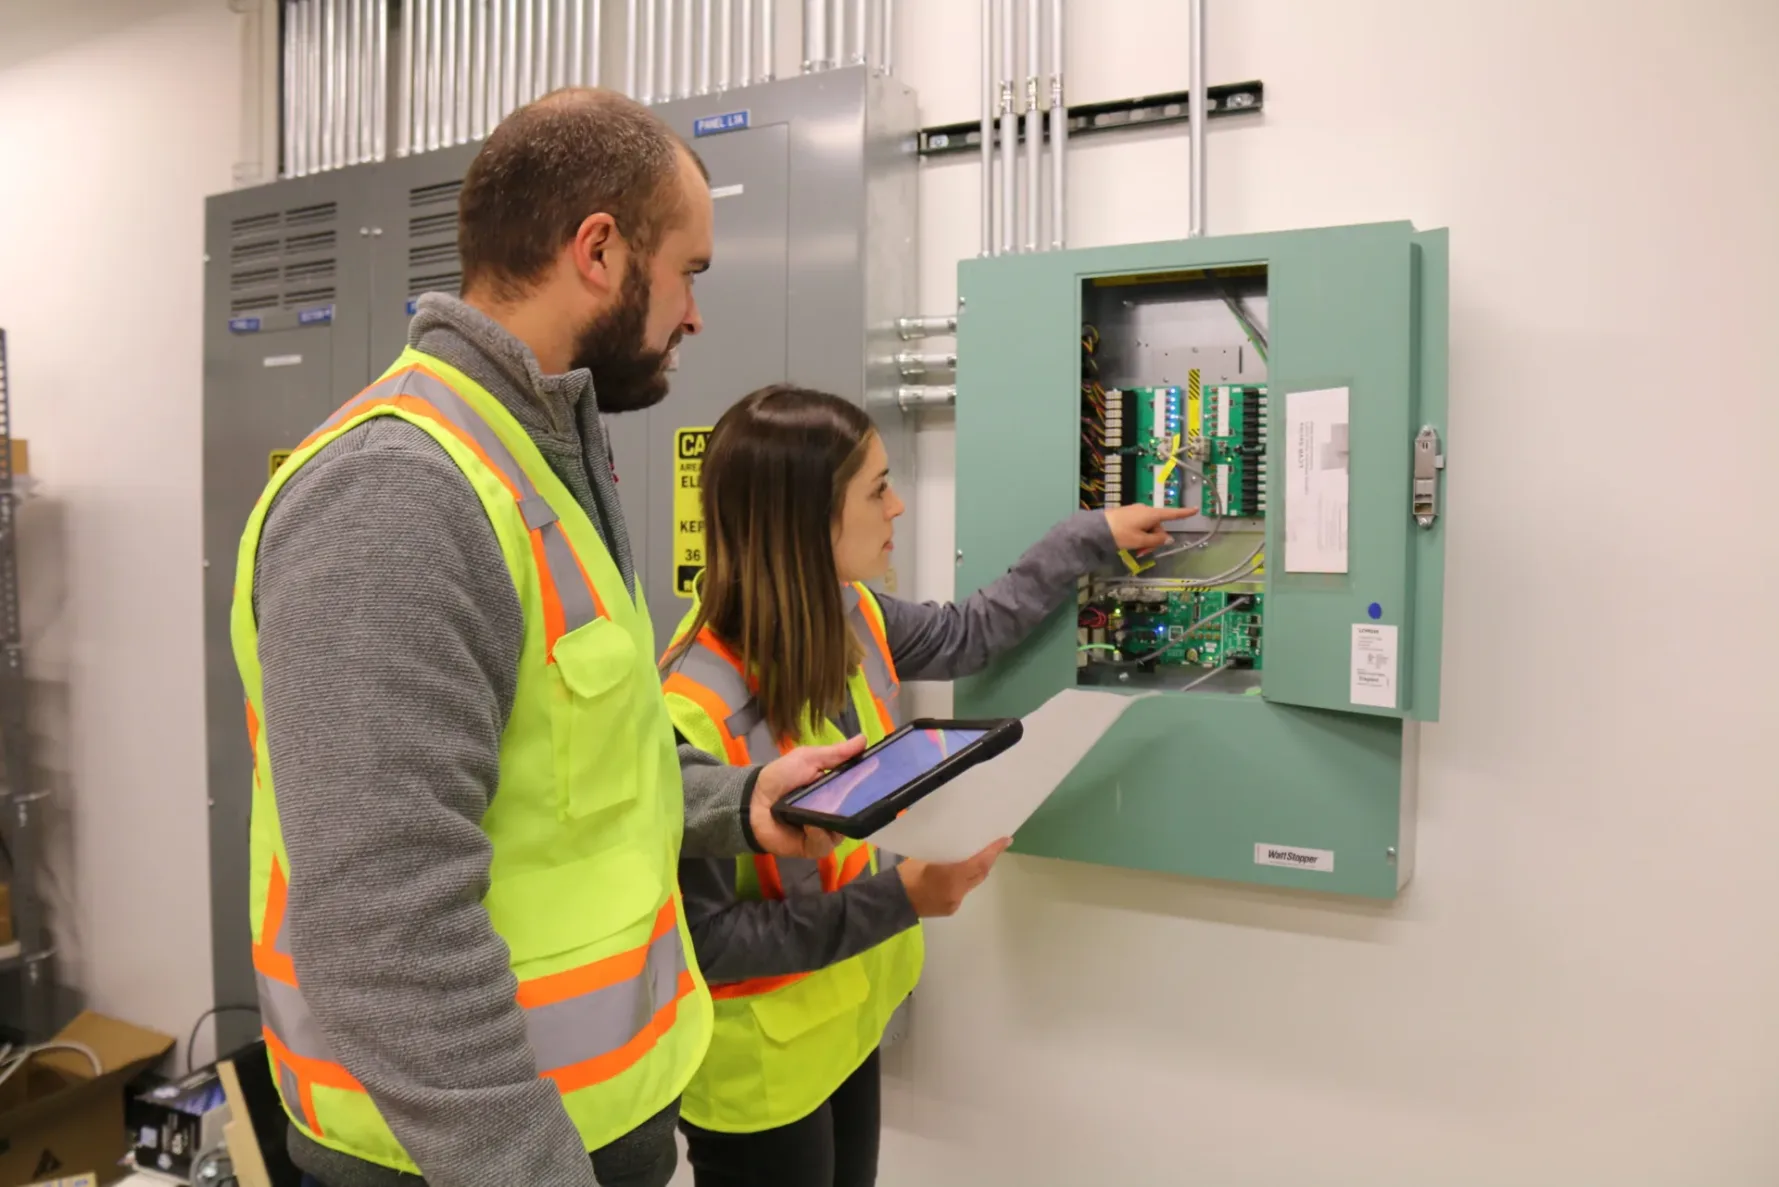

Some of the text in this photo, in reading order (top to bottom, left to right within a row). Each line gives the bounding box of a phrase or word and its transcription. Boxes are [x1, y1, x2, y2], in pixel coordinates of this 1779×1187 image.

[682, 434, 710, 456] CA
[682, 476, 700, 488] EL
[680, 520, 706, 532] KEP
